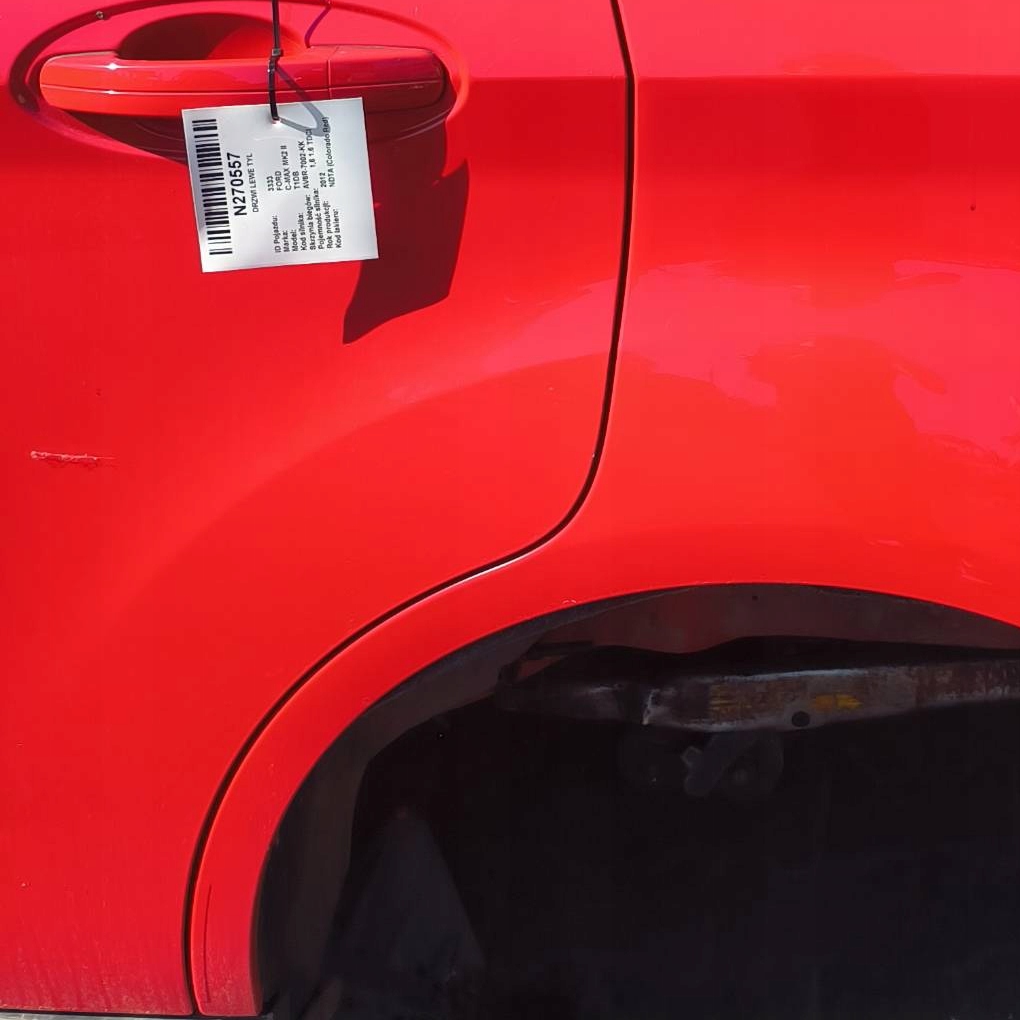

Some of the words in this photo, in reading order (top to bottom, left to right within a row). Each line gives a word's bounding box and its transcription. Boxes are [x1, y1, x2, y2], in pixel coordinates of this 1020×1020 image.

[227, 152, 247, 216] N270557
[248, 168, 256, 188] LEWE
[275, 171, 283, 191] FORD
[283, 168, 292, 190] C-MAX
[319, 173, 327, 187] 2012
[250, 190, 259, 212] DRZWI
